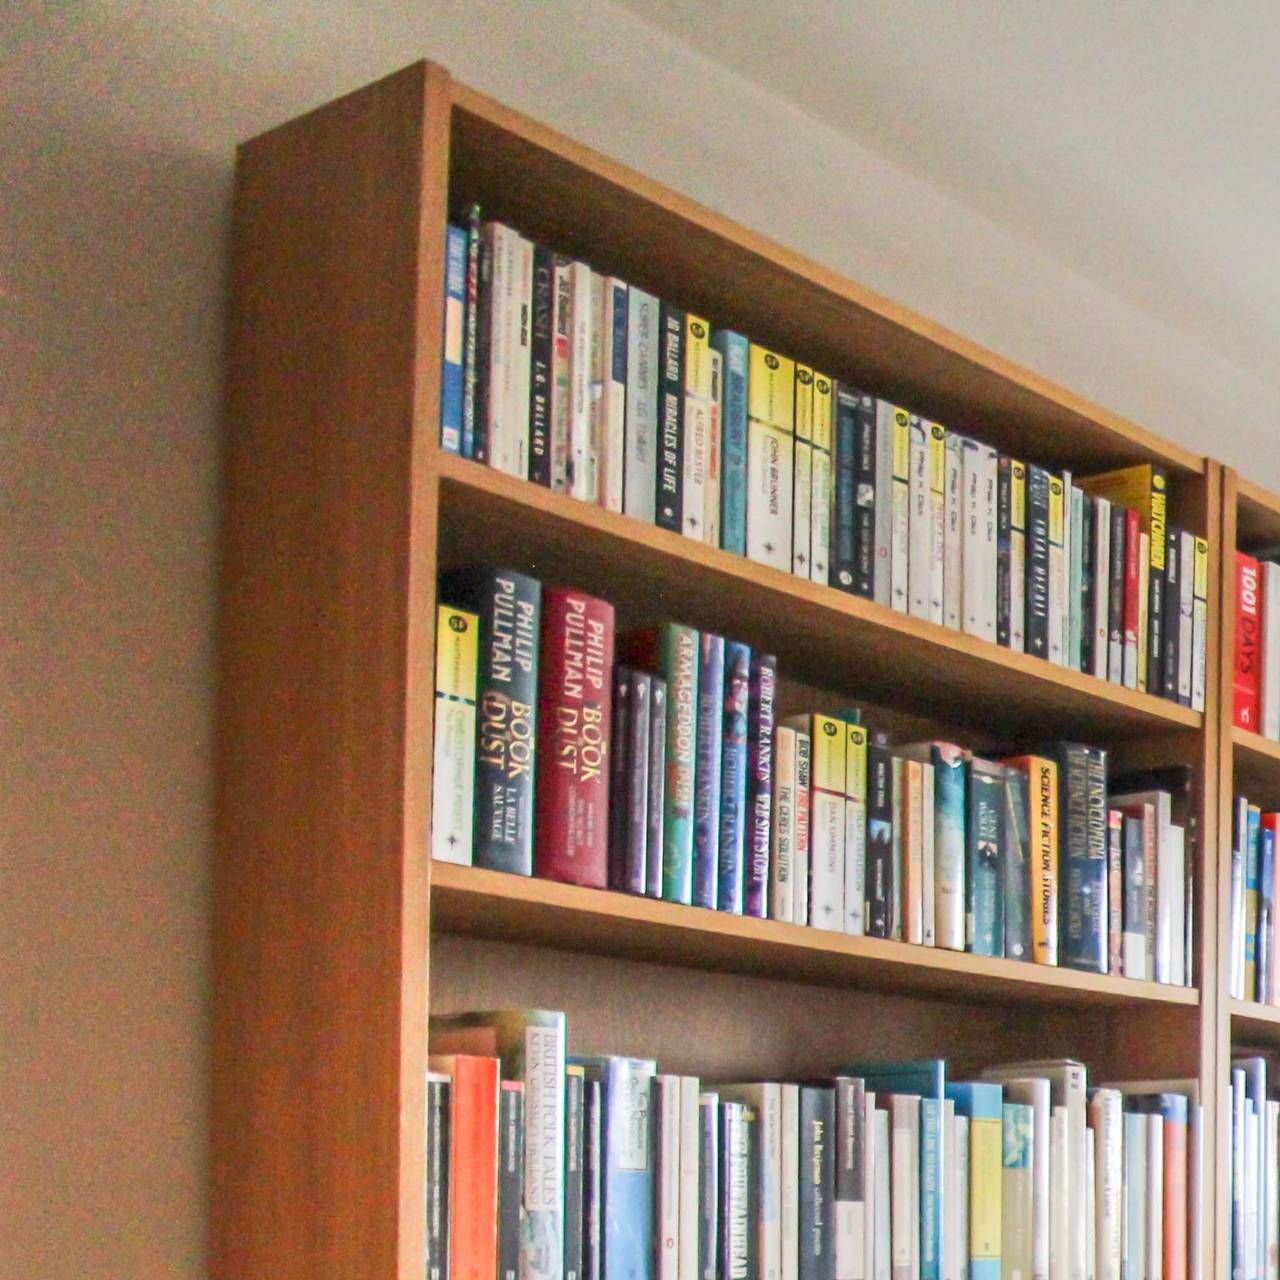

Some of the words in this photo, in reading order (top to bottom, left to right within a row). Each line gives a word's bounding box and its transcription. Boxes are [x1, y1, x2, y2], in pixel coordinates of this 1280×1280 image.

[666, 331, 680, 382] BALLARD
[534, 395, 545, 456] BALLARD
[664, 392, 679, 449] MIRACLES
[663, 468, 677, 494] LIFE
[664, 451, 677, 467] OF
[1150, 492, 1166, 571] WATCHMEN
[1241, 566, 1257, 616] 1001
[491, 577, 514, 682] PULLMAN
[516, 601, 534, 672] PHILIP
[564, 598, 584, 699] PULLMAN
[588, 620, 604, 689] PHILIP
[1240, 616, 1255, 674] DAYS
[677, 632, 692, 762] ARMAGEDDON
[759, 667, 773, 723] ROBERT
[480, 702, 505, 771] DUST
[508, 701, 532, 780] BOOK
[557, 708, 577, 774] DUST
[581, 707, 602, 784] BOOK
[758, 725, 771, 782] RANKIN
[797, 739, 809, 759] BOB
[779, 786, 790, 802] THE
[797, 762, 809, 788] SHAW
[1041, 767, 1051, 818] SCIENCE
[779, 806, 790, 834] CERES
[1041, 822, 1051, 871] FICTION
[1088, 782, 1104, 860] ENCYCLOPEDIA
[778, 837, 790, 882] SOLUTION
[543, 1034, 557, 1097] BRITISH
[543, 1104, 557, 1146] FOLK
[812, 1121, 823, 1142] John
[543, 1155, 556, 1206] TALES
